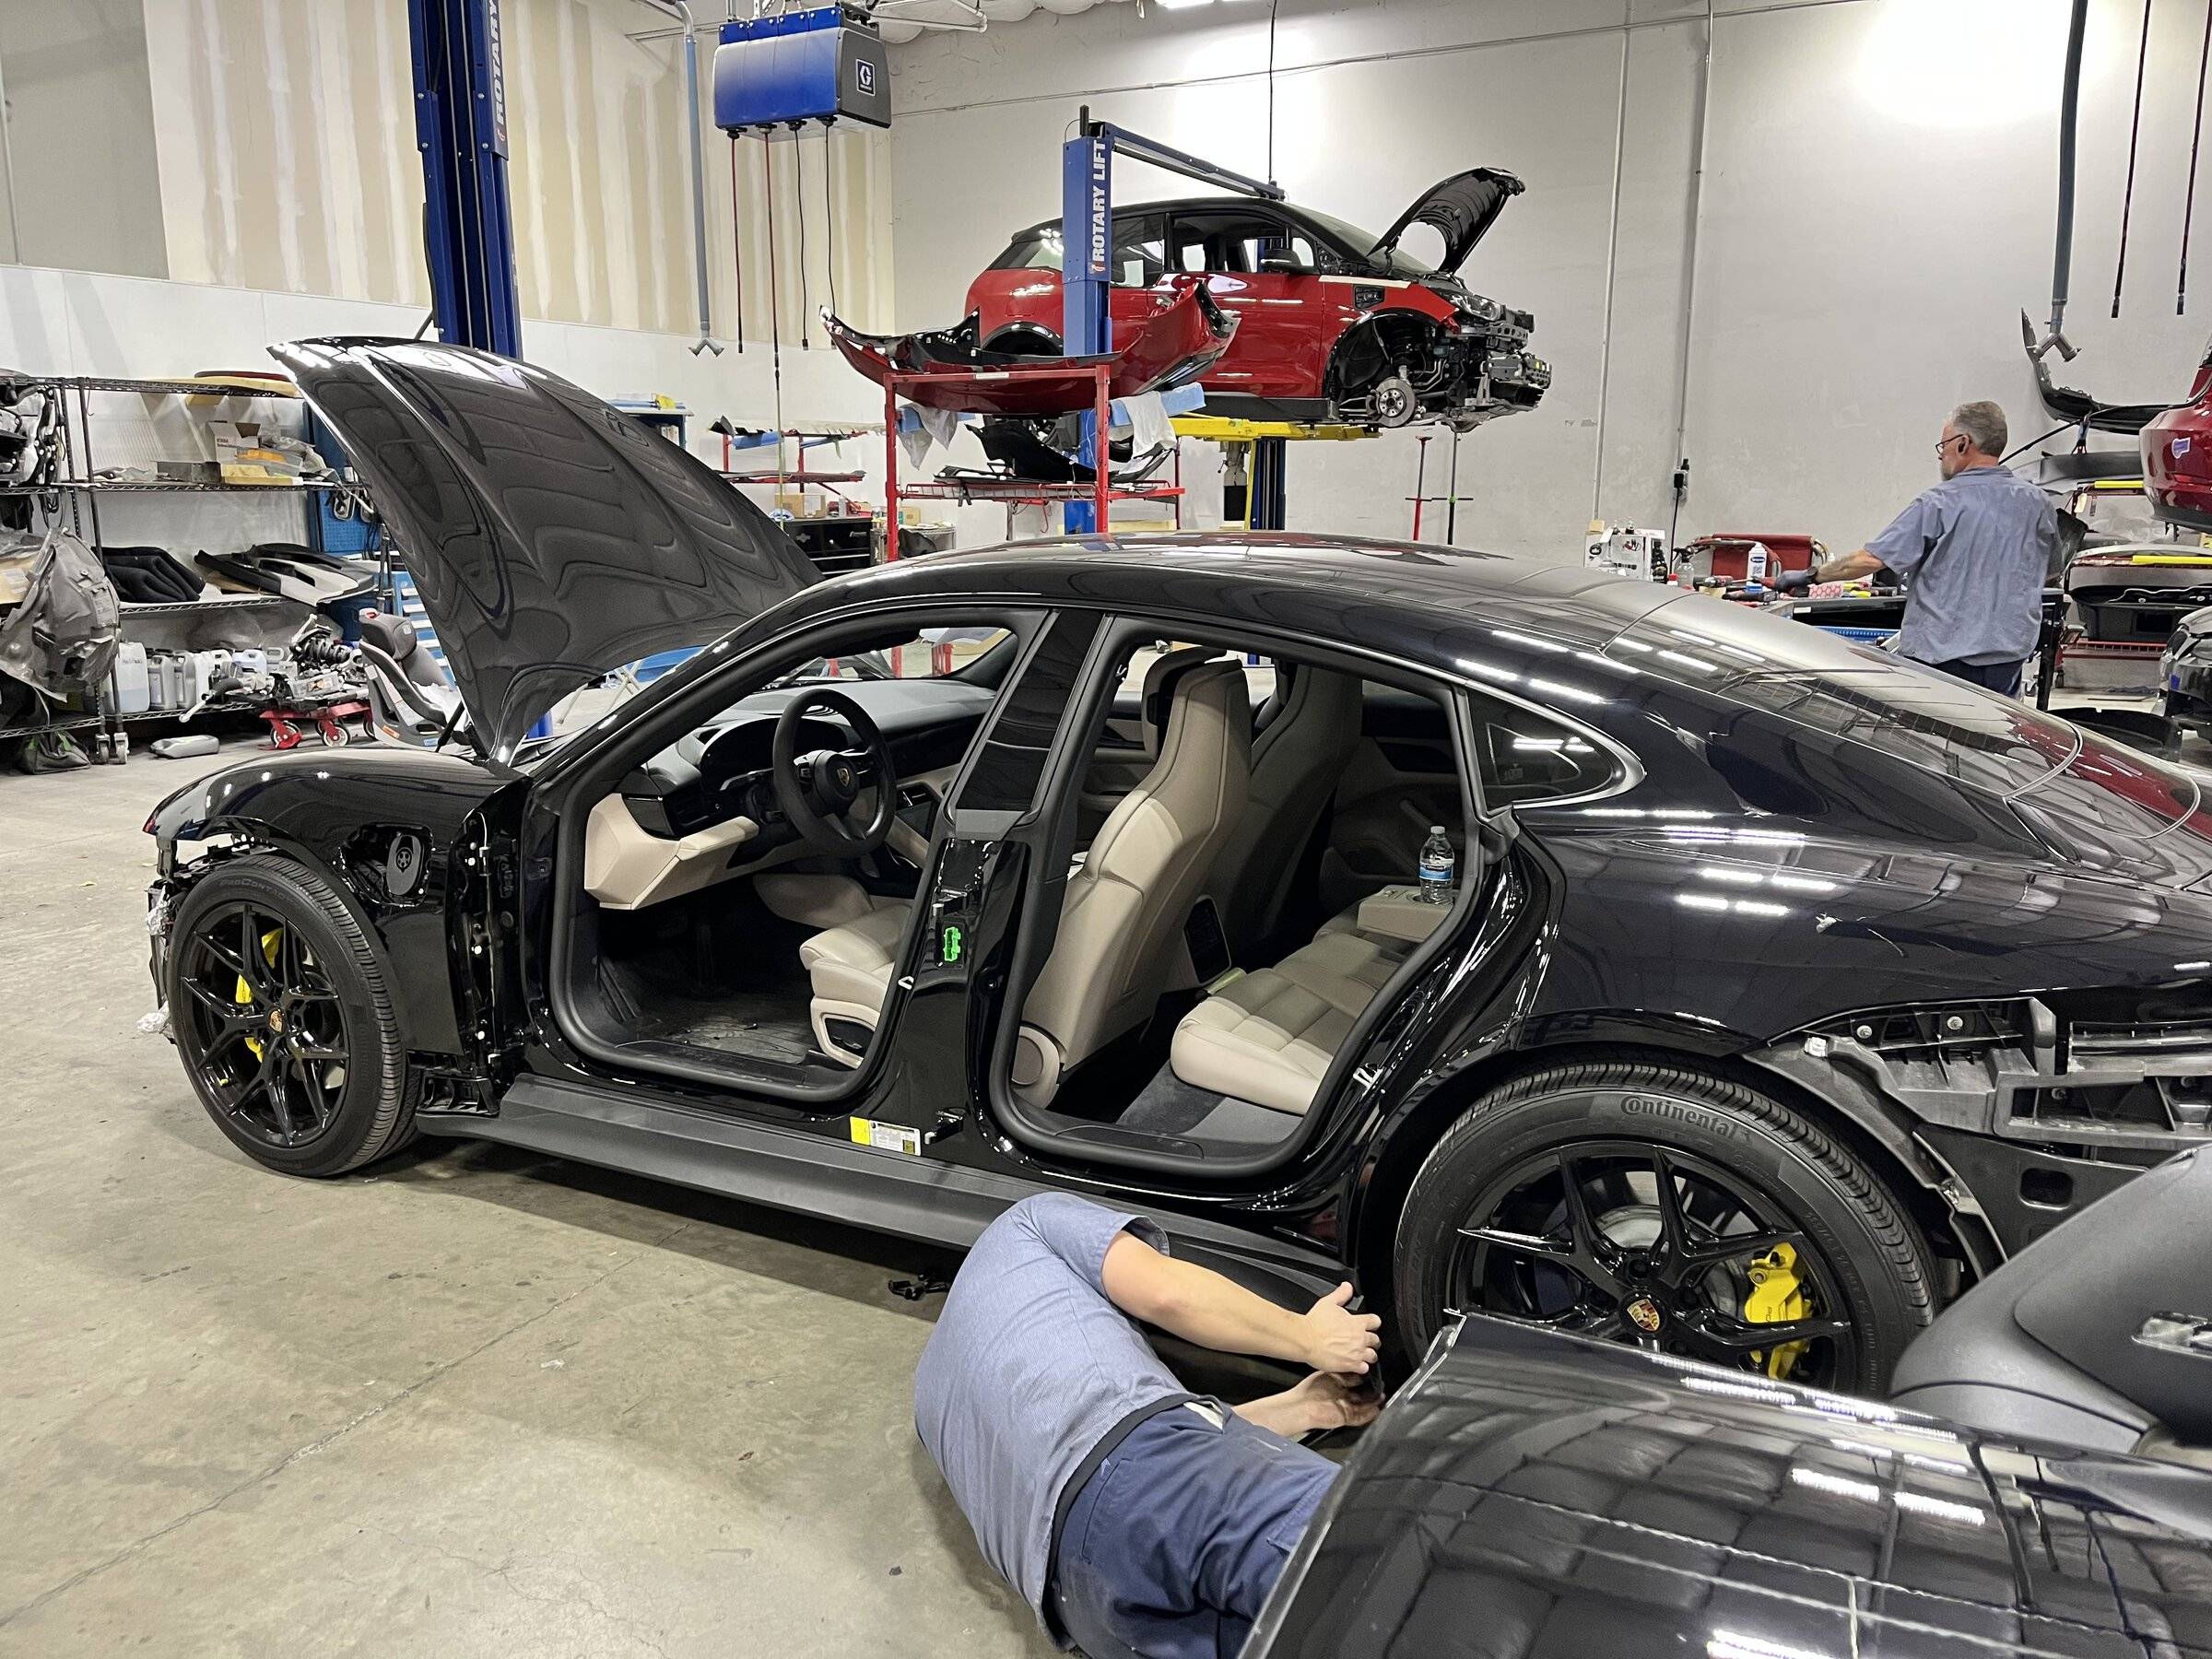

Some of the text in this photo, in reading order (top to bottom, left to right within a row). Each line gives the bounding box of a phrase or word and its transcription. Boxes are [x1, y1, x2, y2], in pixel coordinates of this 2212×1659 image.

[488, 0, 504, 125] ROTARY
[1092, 139, 1106, 262] ROTARY LIFT
[1619, 1095, 1738, 1141] Continental
